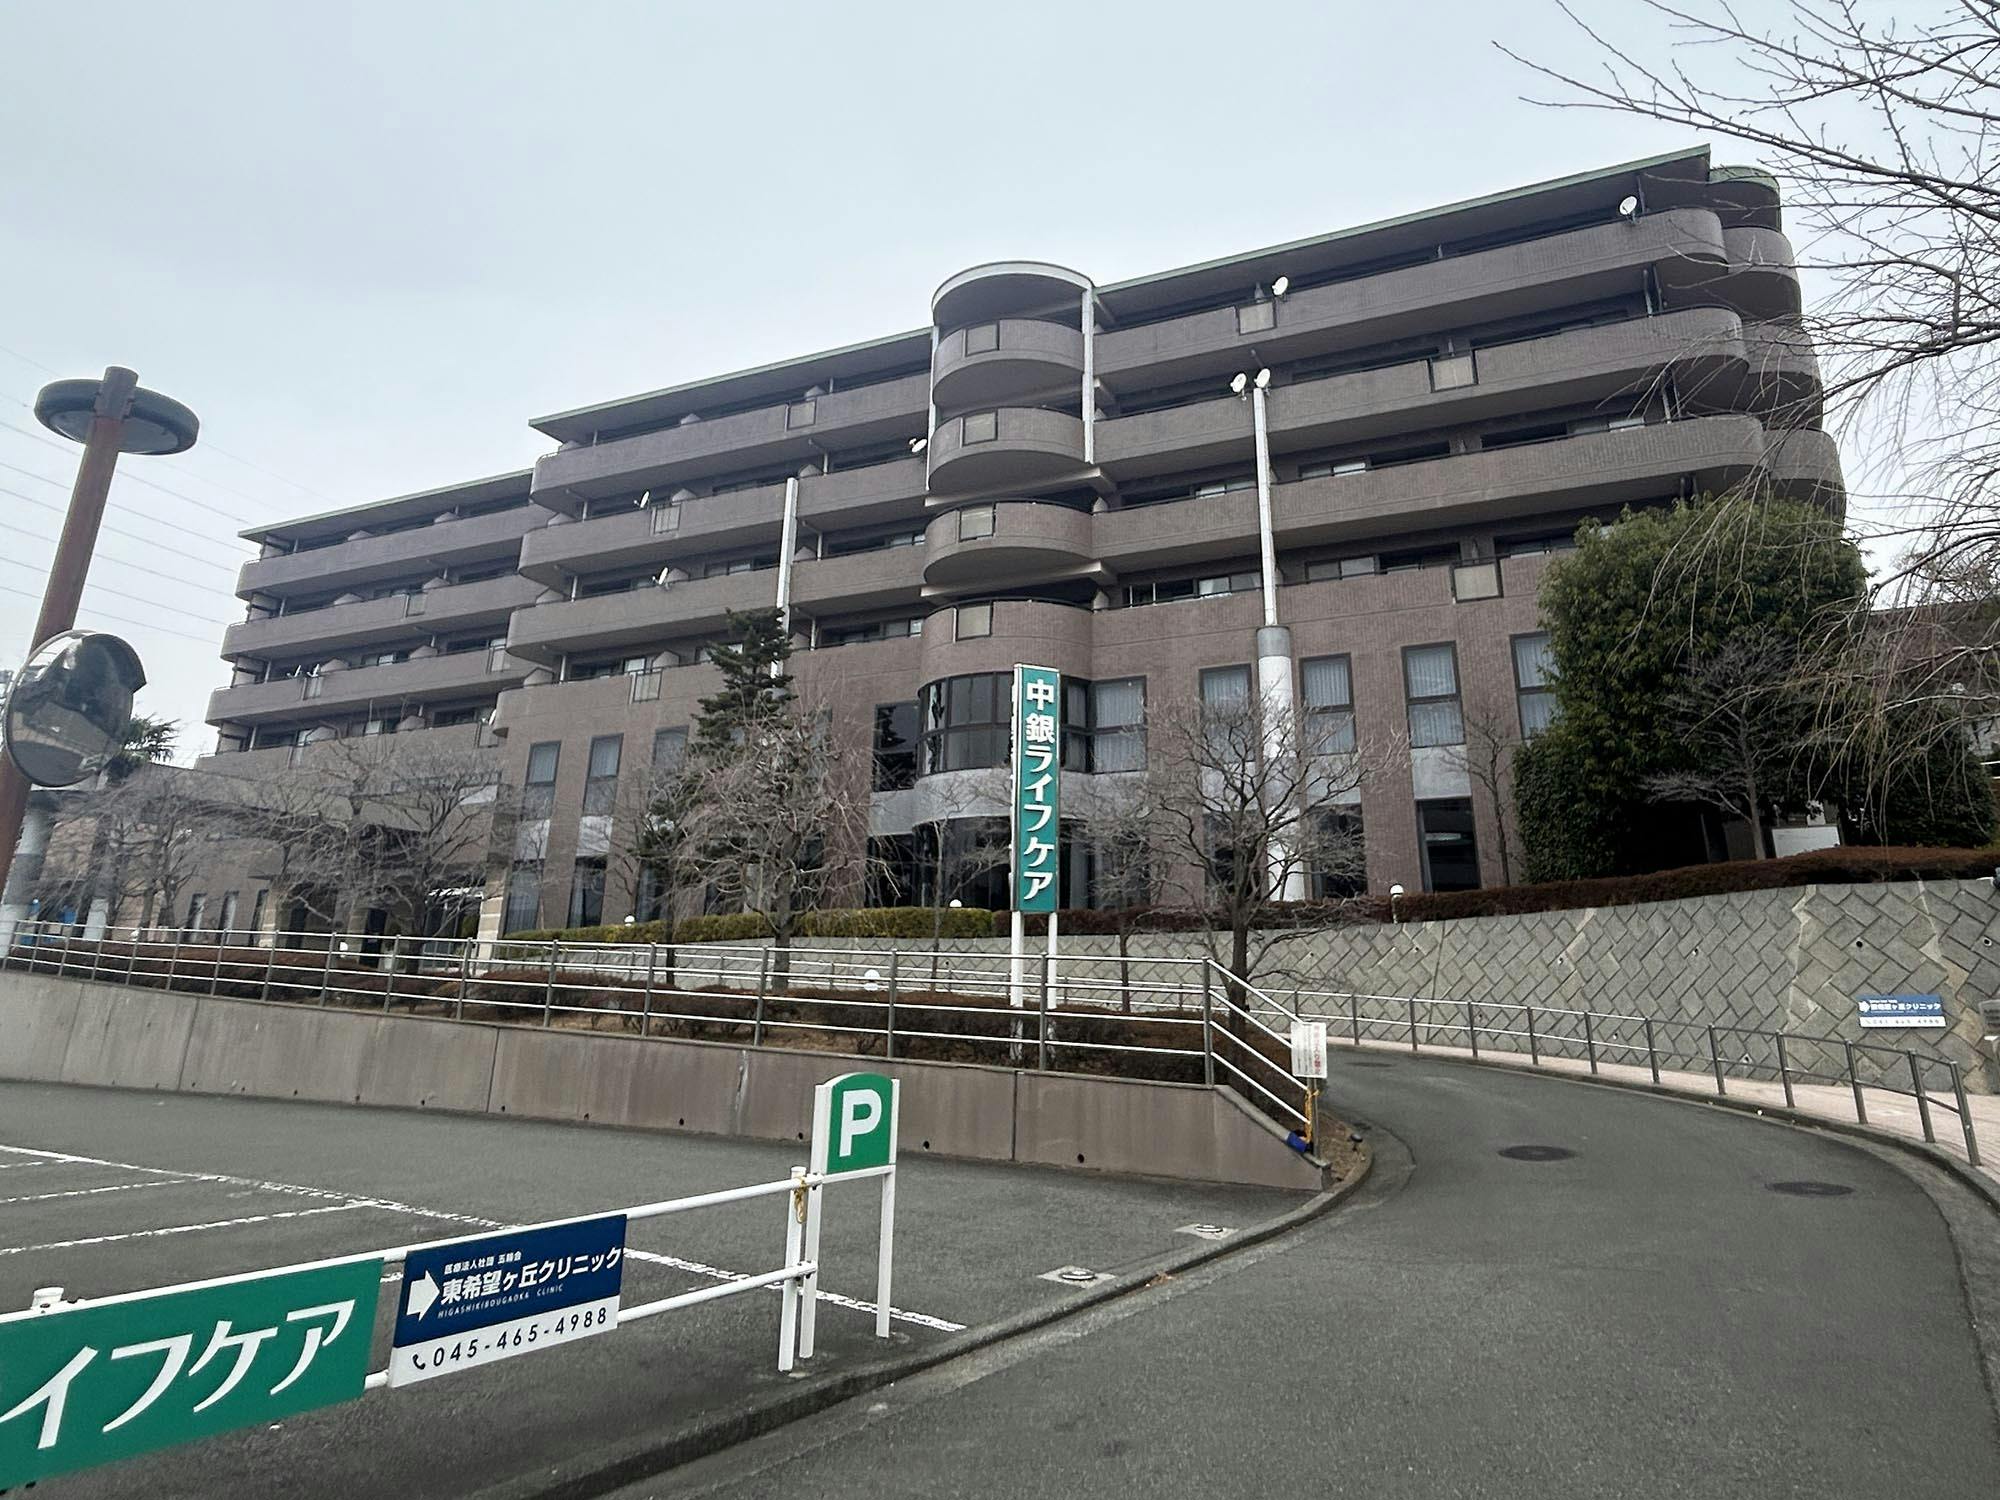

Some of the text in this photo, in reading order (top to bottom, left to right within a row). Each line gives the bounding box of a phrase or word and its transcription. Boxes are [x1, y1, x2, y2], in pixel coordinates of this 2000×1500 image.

[1023, 678, 1056, 901] 中銀ライフケア
[839, 1088, 883, 1157] P
[440, 1246, 622, 1305] 東希望ヶ丘クリニック
[536, 1284, 564, 1297] CLINIC
[432, 1307, 607, 1367] 045-465-4988
[0, 1299, 356, 1450] イフケア
